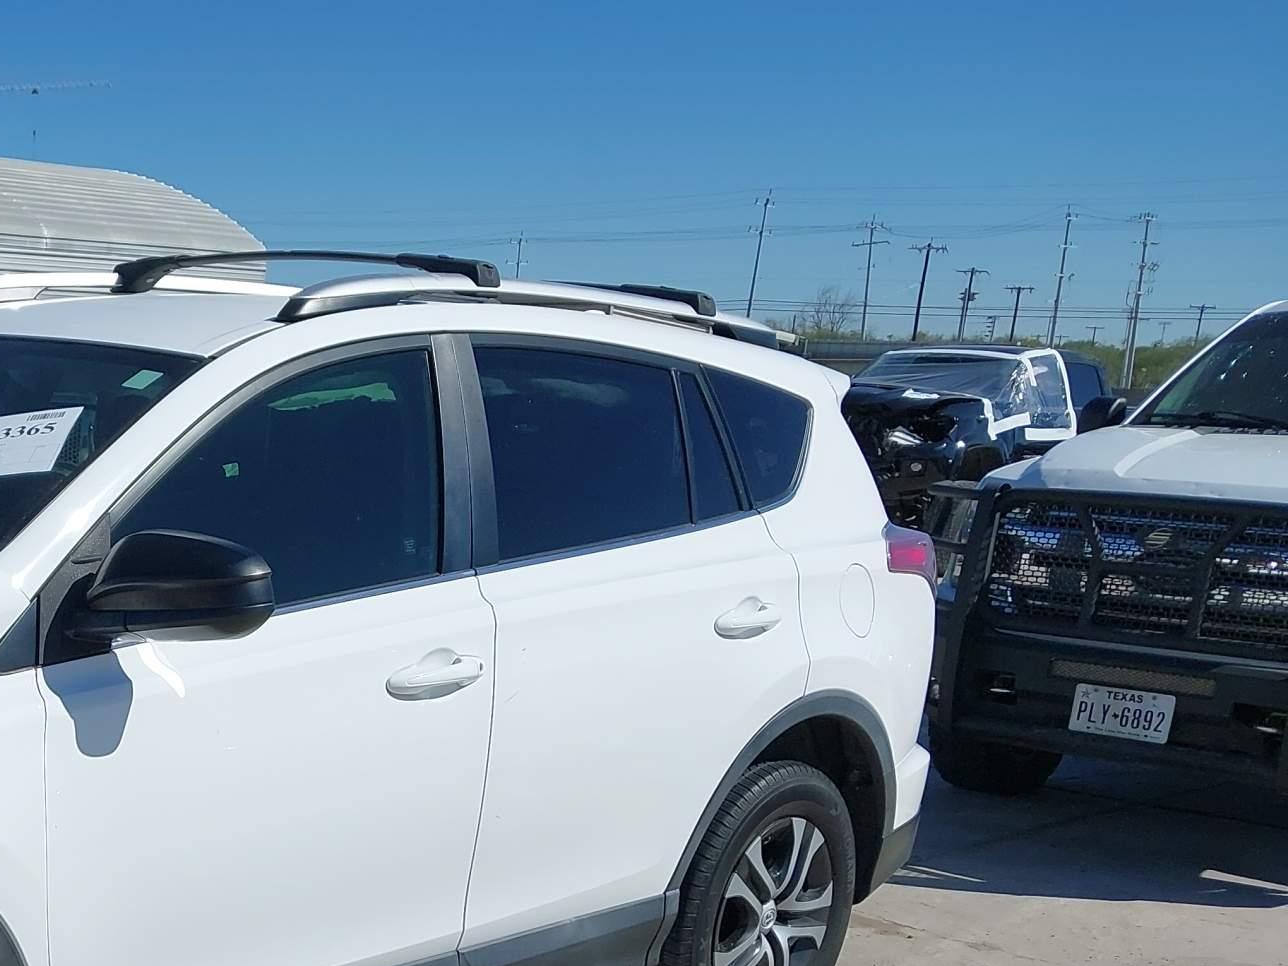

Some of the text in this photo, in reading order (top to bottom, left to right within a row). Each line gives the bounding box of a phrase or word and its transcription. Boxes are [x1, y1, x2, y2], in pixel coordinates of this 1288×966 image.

[1106, 690, 1144, 704] TEXAS
[1076, 701, 1112, 725] PLY
[1119, 706, 1166, 733] 6892
